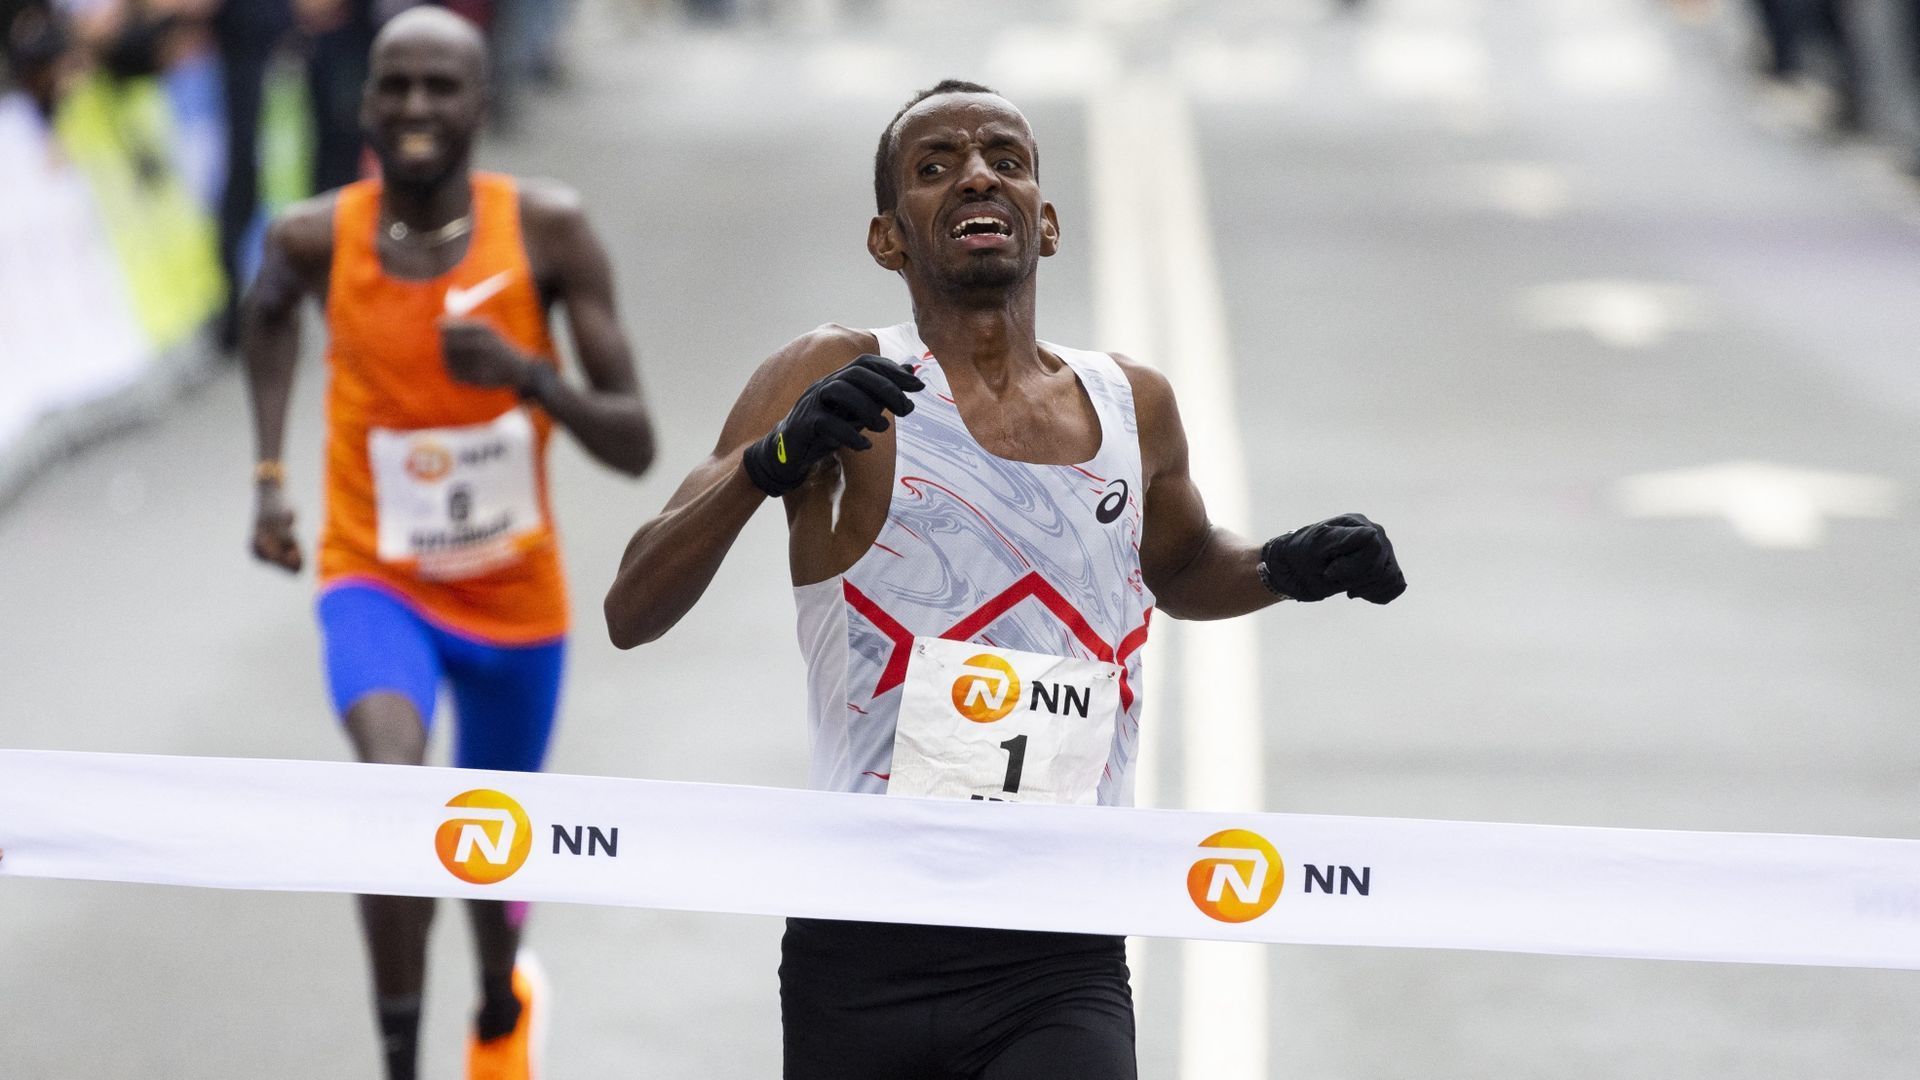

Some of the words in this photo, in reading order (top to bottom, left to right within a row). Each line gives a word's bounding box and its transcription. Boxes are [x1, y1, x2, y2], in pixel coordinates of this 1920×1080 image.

[1029, 680, 1091, 719] NN
[999, 734, 1028, 794] 1
[551, 824, 619, 858] NN
[1303, 863, 1371, 897] NN
